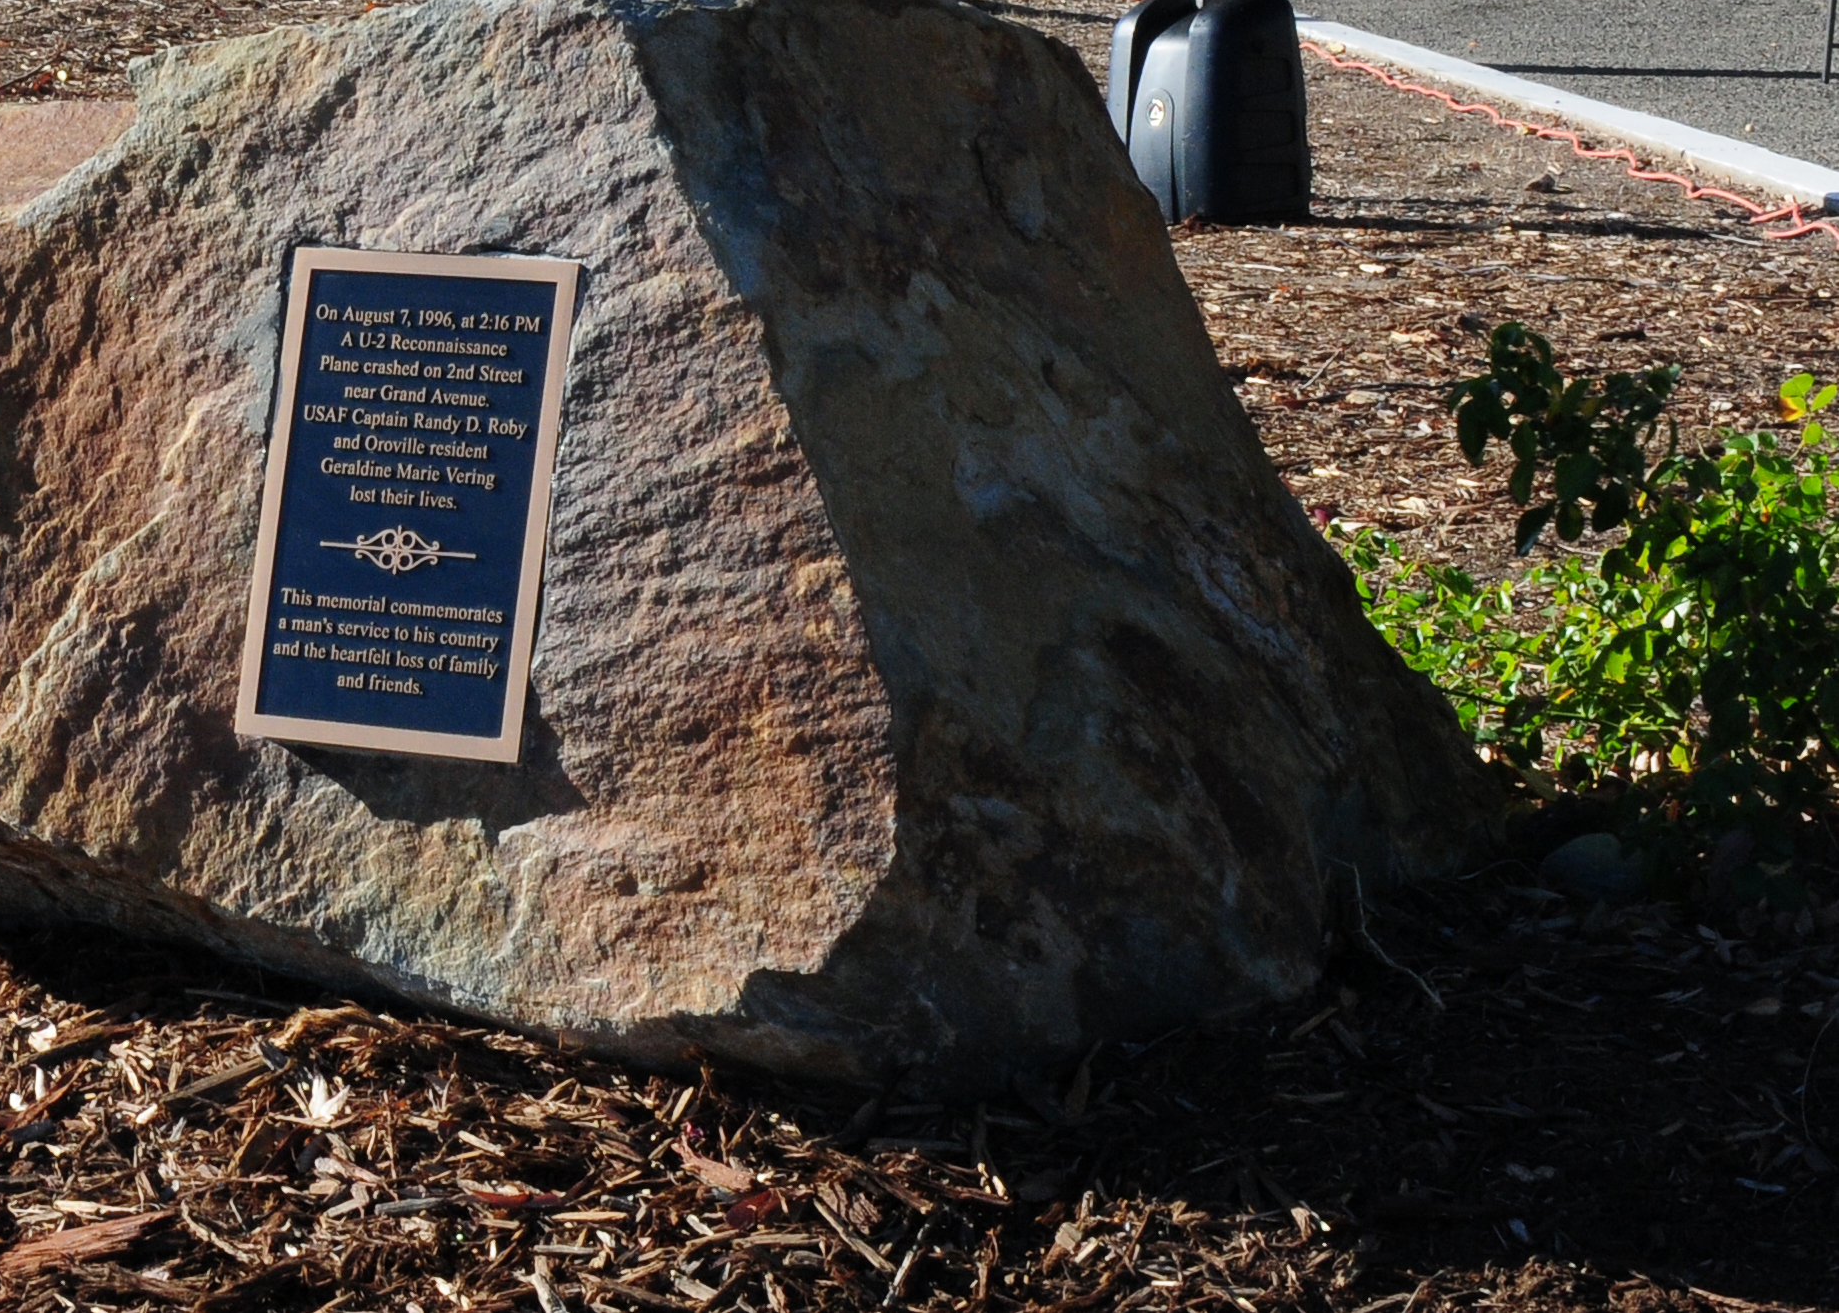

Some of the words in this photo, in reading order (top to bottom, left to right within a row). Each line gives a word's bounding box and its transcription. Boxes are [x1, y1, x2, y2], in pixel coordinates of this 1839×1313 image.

[315, 303, 338, 320] On
[342, 305, 395, 327] August
[400, 308, 411, 327] 7,
[418, 309, 456, 330] 1996,
[460, 315, 475, 329] at
[479, 312, 510, 330] 2:16
[514, 315, 540, 333] PM
[340, 331, 353, 347] A
[359, 331, 386, 349] U-2
[390, 333, 507, 357] Reconnaissance
[319, 354, 360, 373] Plane
[363, 359, 420, 377] crashed
[423, 365, 442, 378] on
[446, 363, 475, 380] 2nd
[479, 365, 523, 383] Street
[344, 386, 377, 400] near
[380, 384, 427, 403] Grand
[430, 388, 490, 408] Avenue.
[303, 404, 349, 423] USAF
[351, 408, 408, 430] Captain
[413, 412, 461, 435] Randy
[465, 415, 482, 433] D.
[488, 417, 527, 440] Roby
[333, 433, 361, 450] and
[364, 434, 425, 455] Oroville
[429, 441, 488, 459] resident
[320, 457, 392, 478] Geraldine
[396, 462, 440, 482] Marie
[446, 466, 495, 490] Vering
[349, 484, 376, 503] lost
[380, 487, 415, 506] their
[419, 490, 458, 510] lives.
[281, 587, 312, 606] This
[316, 595, 386, 613] memorial
[390, 602, 503, 623] commemorates
[278, 617, 287, 630] a
[291, 617, 333, 634] man's
[337, 621, 390, 639] service
[394, 626, 409, 641] to
[413, 625, 435, 643] his
[439, 632, 499, 653] country
[272, 640, 300, 657] and
[304, 641, 326, 659] the
[330, 643, 391, 665] heartfelt
[395, 650, 424, 669] loss
[428, 654, 447, 671] of
[448, 655, 499, 680] family
[336, 672, 364, 689] and
[368, 673, 424, 695] friends.
